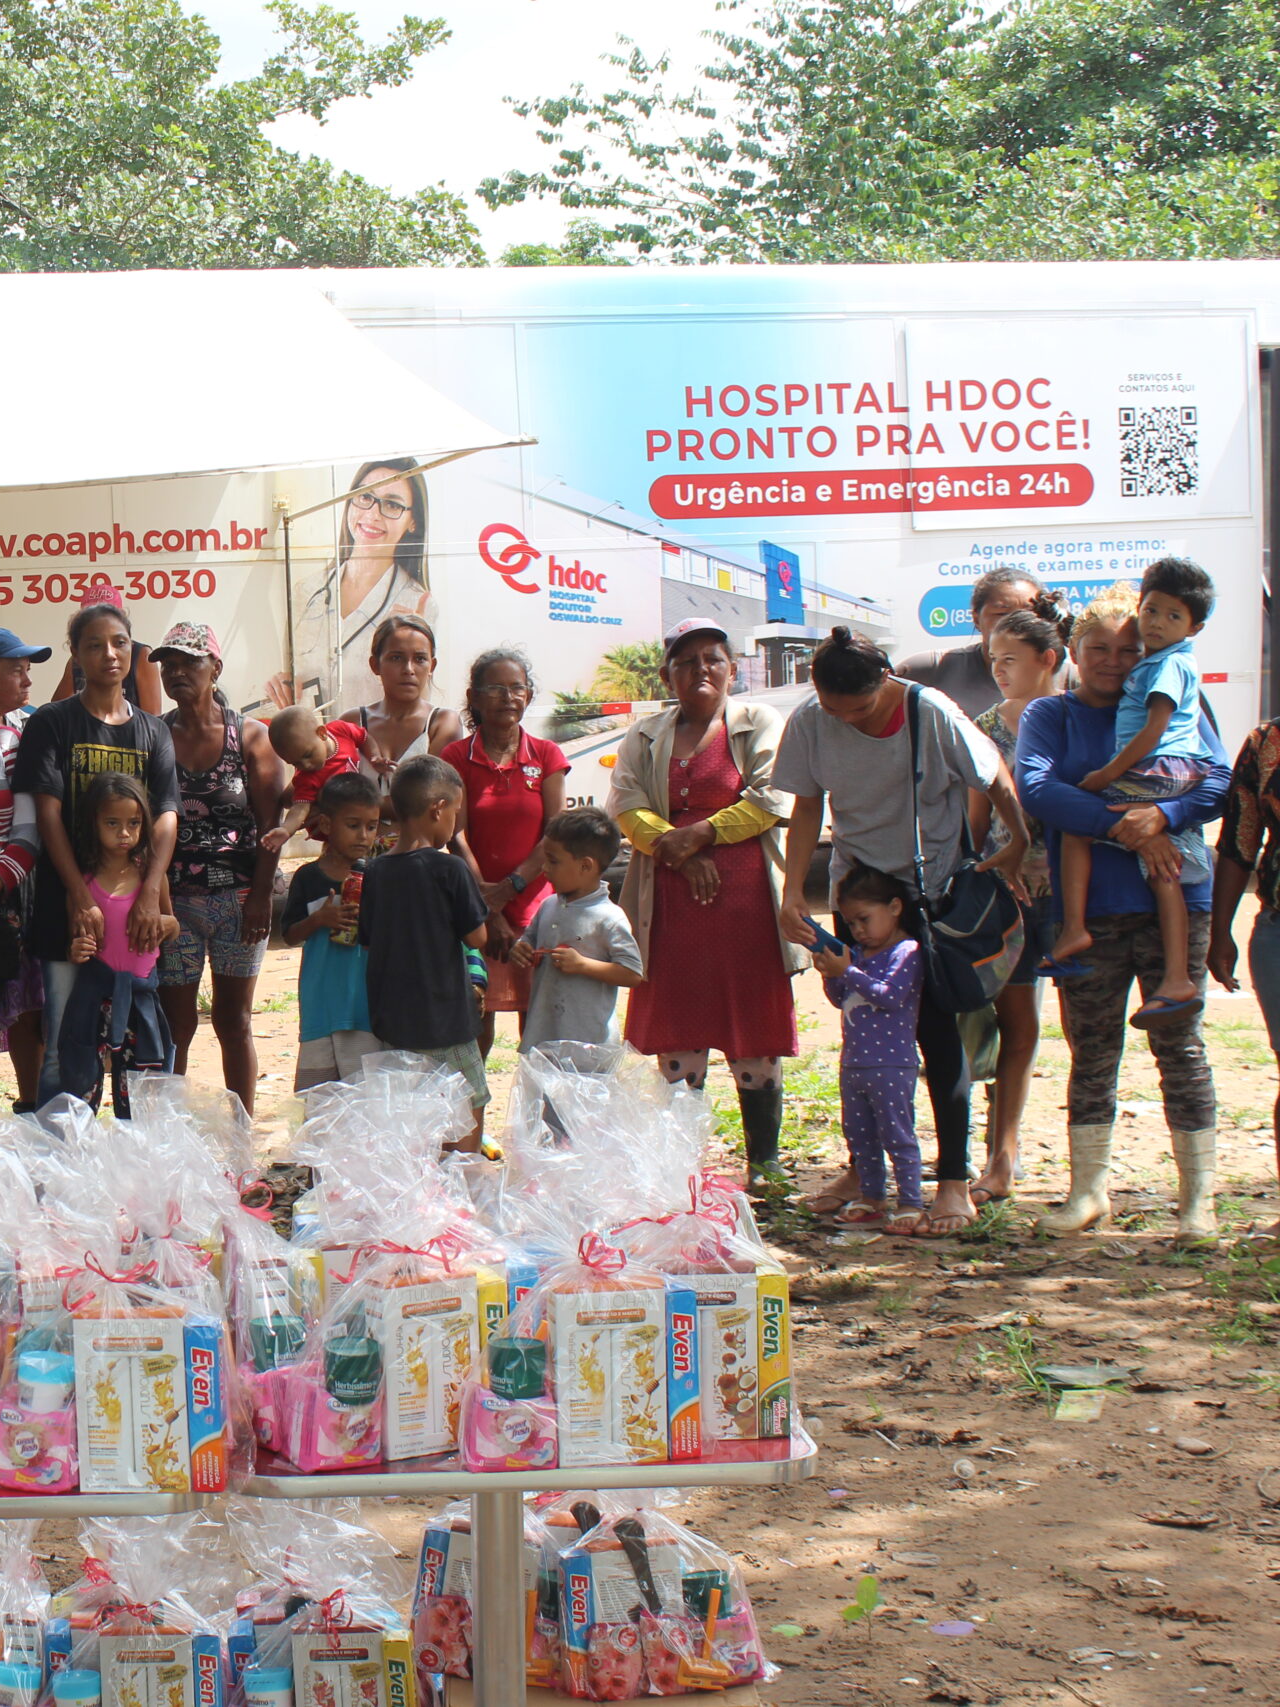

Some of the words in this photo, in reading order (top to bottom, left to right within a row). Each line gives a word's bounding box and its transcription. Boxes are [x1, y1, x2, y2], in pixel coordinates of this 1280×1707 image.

[684, 381, 910, 418] HOSPITAL
[925, 377, 1052, 412] HDOC
[1118, 384, 1169, 393] CONTATOS
[1171, 384, 1195, 393] AQUI
[1127, 373, 1173, 383] SERVIÇOS
[645, 425, 838, 462] PRONTO
[855, 422, 945, 457] PRA
[959, 410, 1091, 453] VOCÊ!
[673, 478, 806, 511] Urgência
[815, 483, 833, 503] e
[842, 472, 1012, 505] Emergência
[1019, 471, 1071, 496] 24h
[969, 541, 1039, 561] Agende
[1043, 541, 1094, 558] agora
[1099, 538, 1167, 553] mesmo:
[1036, 559, 1104, 574] exames
[1109, 559, 1119, 570] e
[548, 554, 608, 594] hdoc
[548, 590, 598, 604] HOSPITAL
[548, 601, 593, 614] DOUTOR
[548, 612, 599, 625] OSWALDO
[599, 616, 623, 626] CRUZ
[88, 748, 136, 777] HIGH
[672, 1312, 696, 1374] Even
[762, 1295, 785, 1358] Even
[191, 1347, 215, 1410] Even
[569, 1573, 590, 1625] Even
[198, 1653, 219, 1706] Even
[388, 1659, 407, 1707] Even
